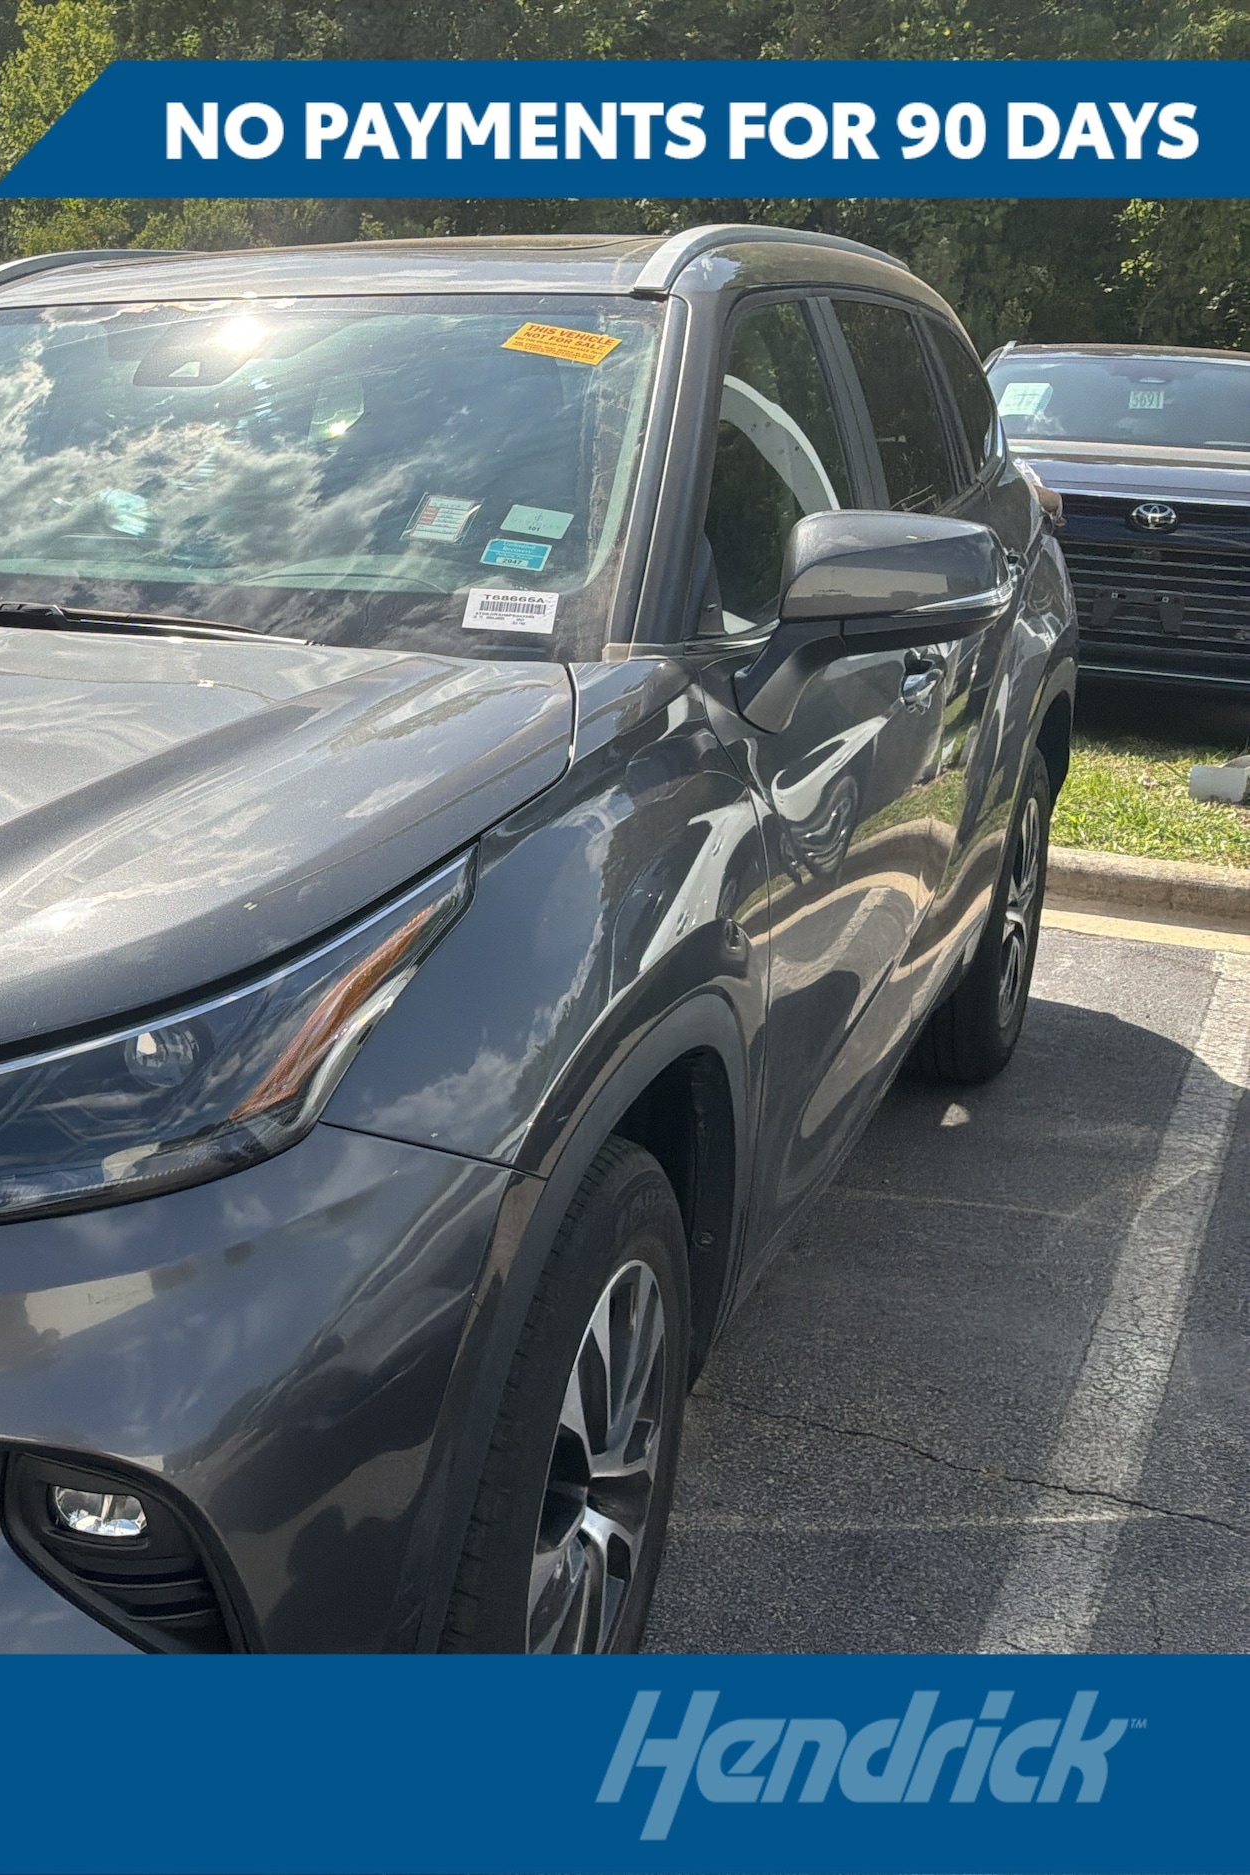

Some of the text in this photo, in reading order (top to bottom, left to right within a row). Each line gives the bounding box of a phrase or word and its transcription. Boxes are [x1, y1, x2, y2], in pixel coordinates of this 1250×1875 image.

[524, 331, 549, 340] NOT
[550, 335, 574, 345] FOR
[574, 340, 606, 351] SALE
[529, 324, 615, 346] THIS VEHICLE
